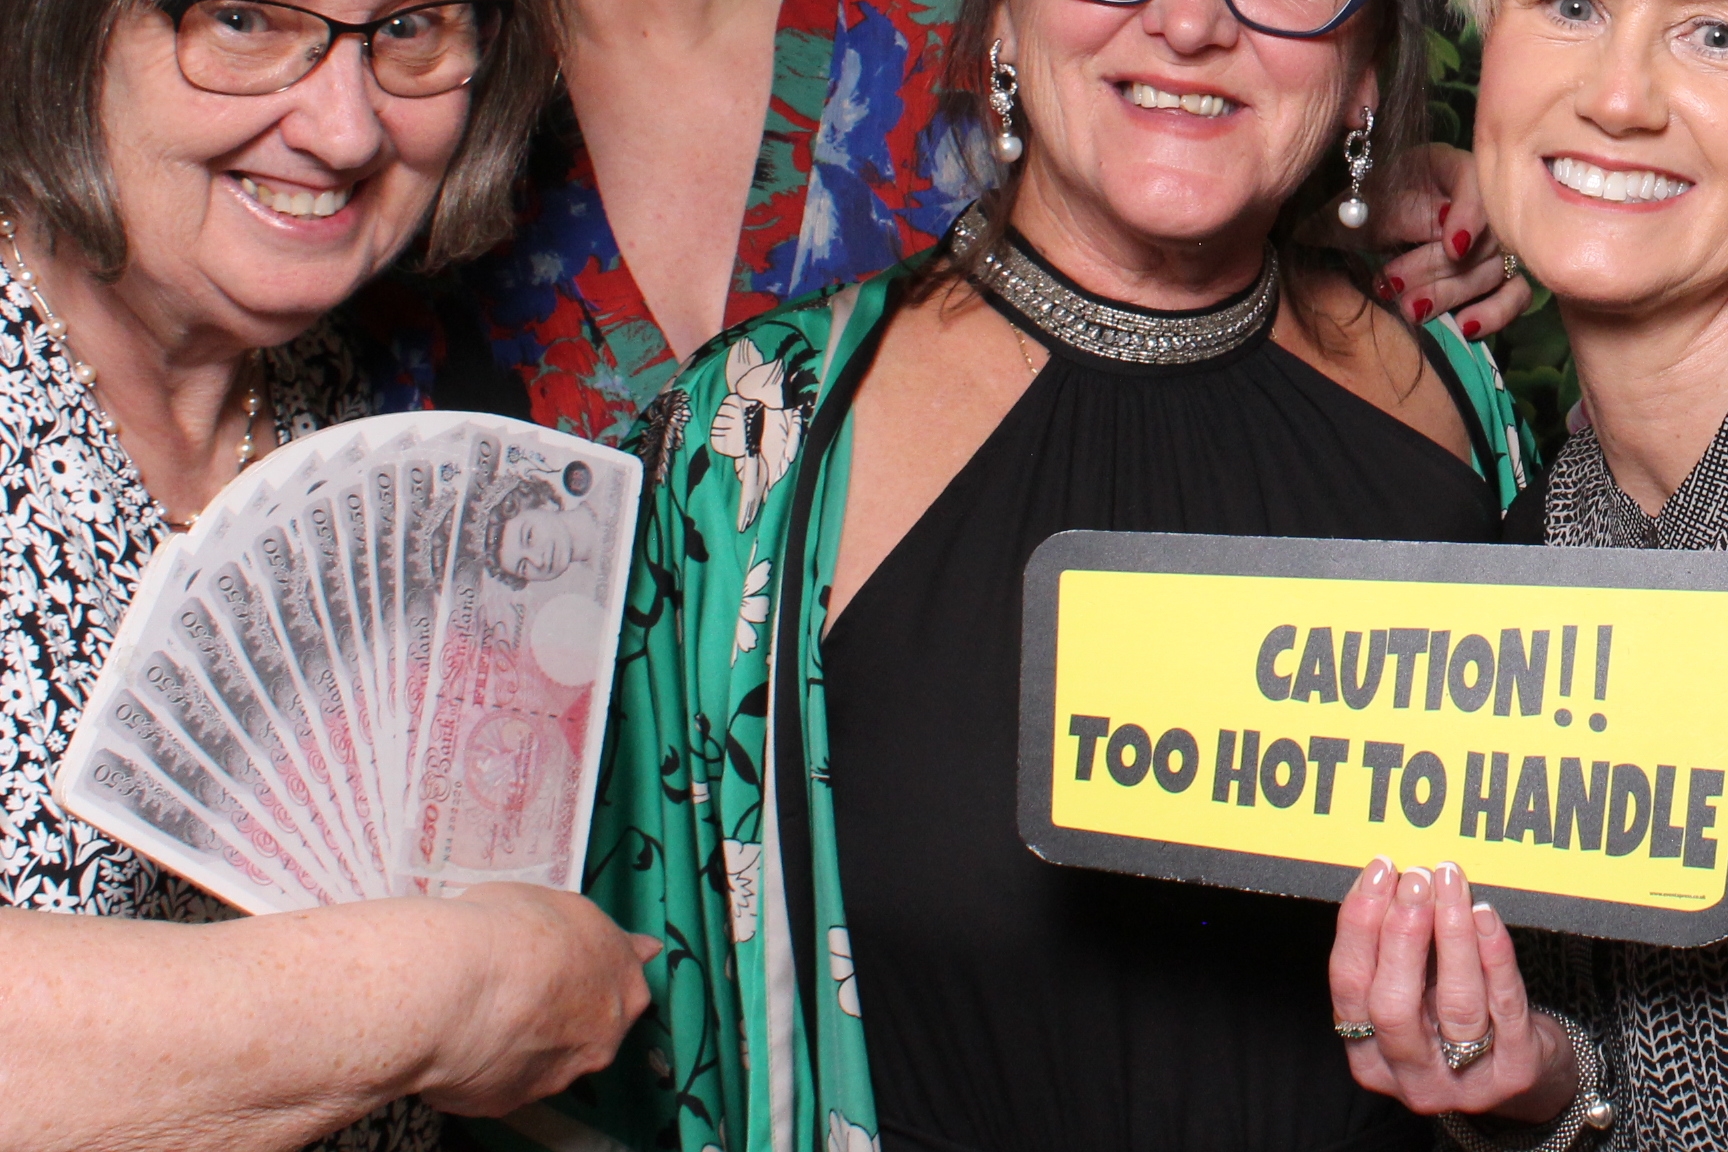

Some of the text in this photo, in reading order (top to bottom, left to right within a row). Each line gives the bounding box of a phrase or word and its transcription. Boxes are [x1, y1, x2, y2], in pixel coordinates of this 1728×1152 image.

[1255, 623, 1613, 732] CAUTION!!
[1068, 713, 1726, 870] TOO HOT TO HANDLE
